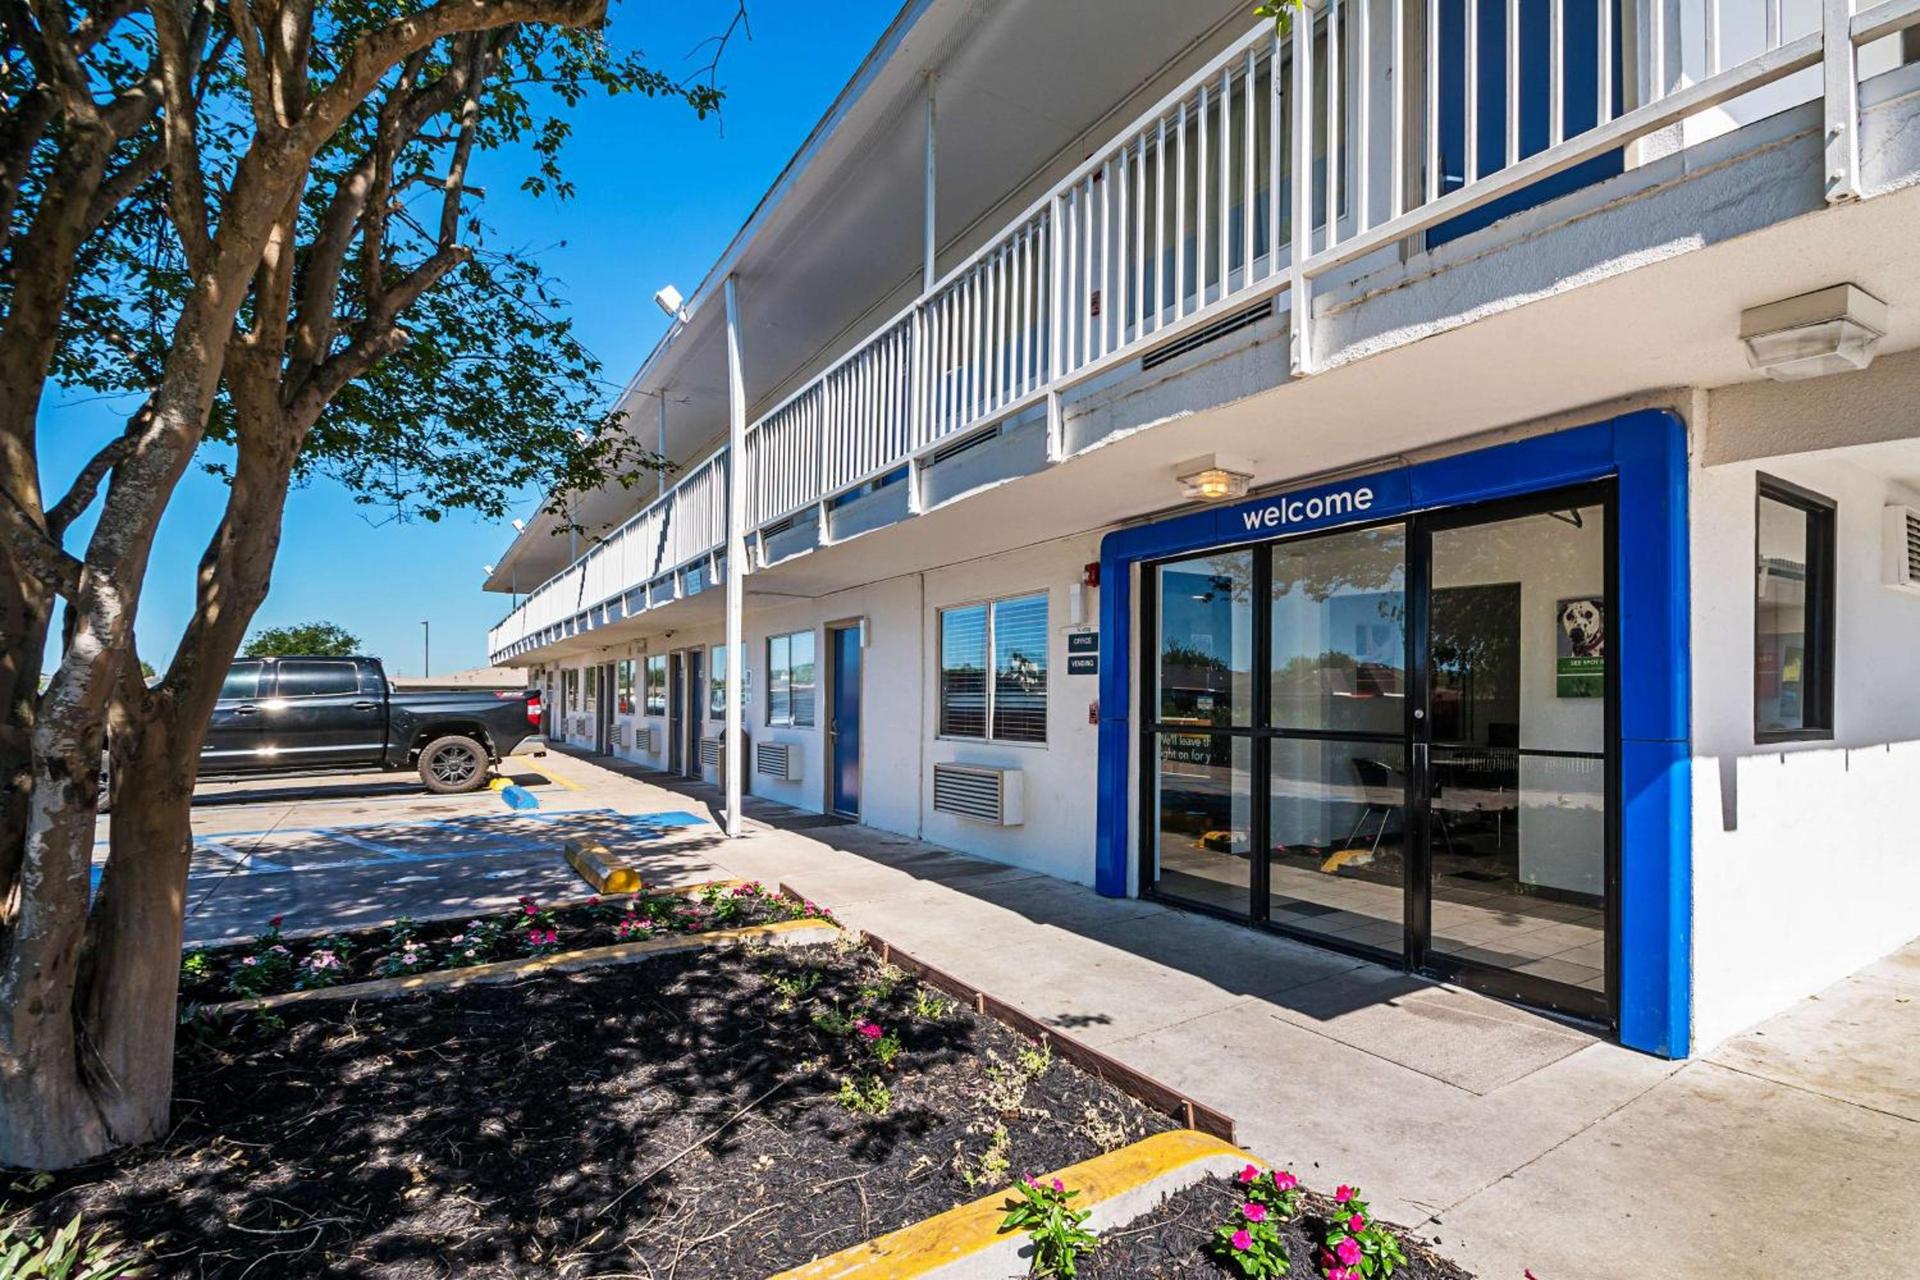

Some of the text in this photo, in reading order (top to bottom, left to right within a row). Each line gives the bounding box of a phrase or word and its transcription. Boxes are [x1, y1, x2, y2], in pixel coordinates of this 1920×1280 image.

[1243, 488, 1374, 530] welcome
[1179, 734, 1202, 747] leave
[1178, 752, 1189, 760] on
[1190, 748, 1203, 761] for
